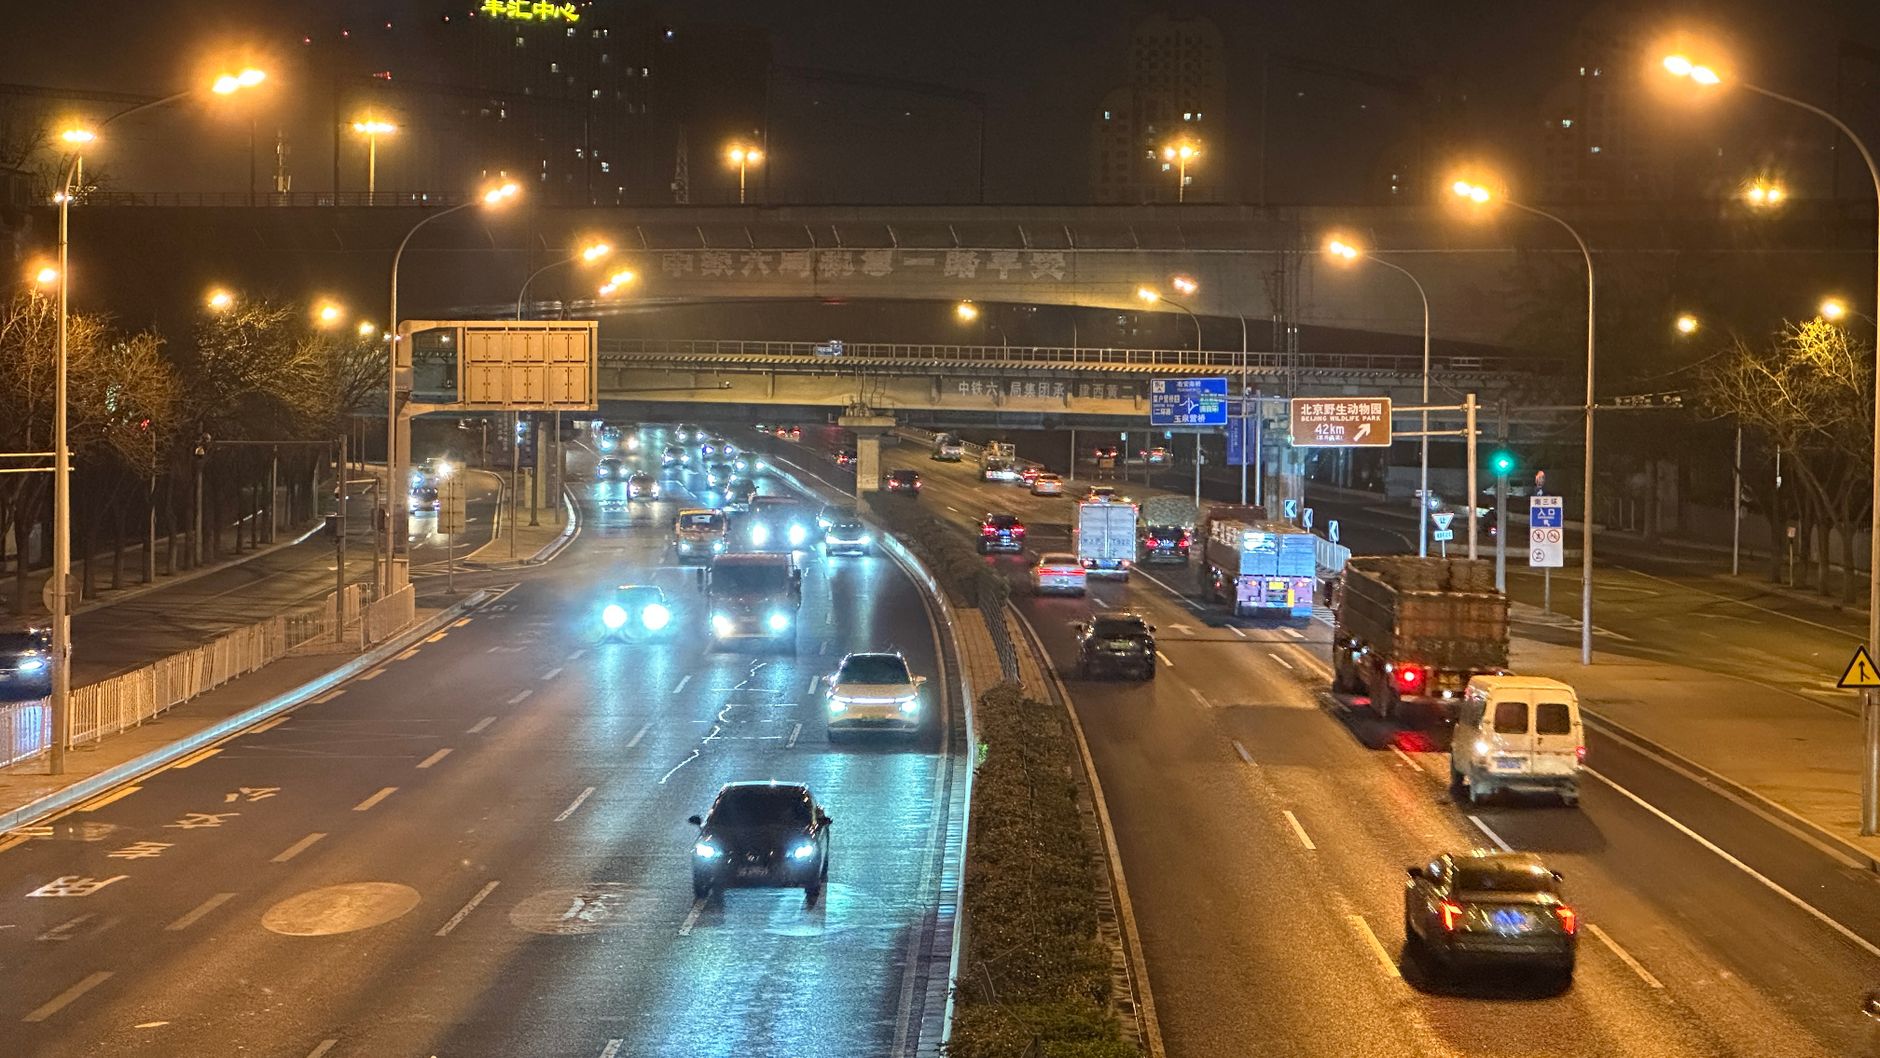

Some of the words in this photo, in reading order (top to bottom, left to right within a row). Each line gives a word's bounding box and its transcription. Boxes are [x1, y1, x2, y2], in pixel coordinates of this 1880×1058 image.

[1301, 403, 1382, 415] 北京野生动物园
[1174, 414, 1206, 423] 玉泉营桥
[1314, 423, 1345, 435] 42km
[1538, 508, 1556, 516] 入口
